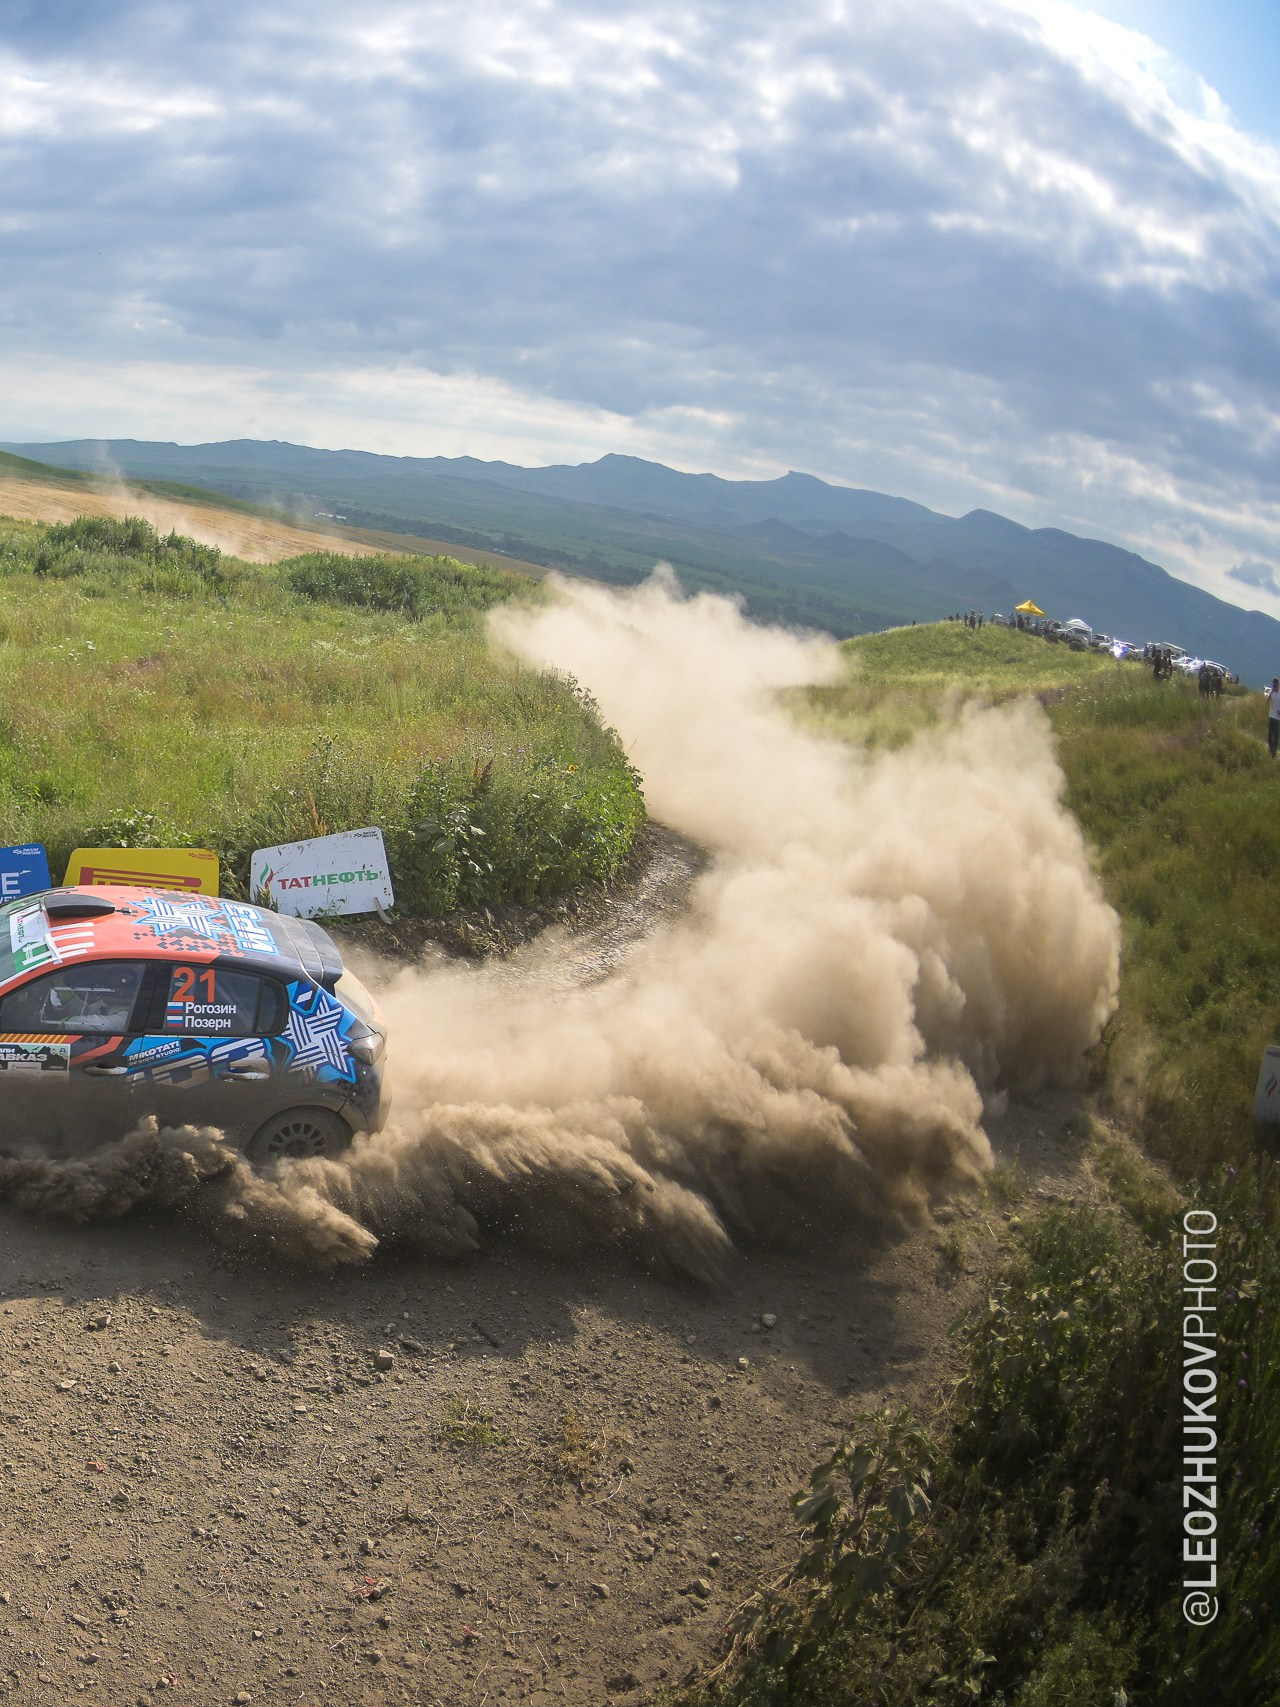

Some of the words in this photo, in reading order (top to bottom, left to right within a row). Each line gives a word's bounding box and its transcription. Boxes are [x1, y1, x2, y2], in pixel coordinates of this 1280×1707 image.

[277, 869, 379, 891] ТАТНЕФТЬ
[172, 966, 215, 1003] 21
[185, 1002, 237, 1014] Рогозин
[184, 1015, 231, 1031] Позерн
[128, 1040, 180, 1062] MIKOTATI
[155, 1047, 180, 1059] STUDIO
